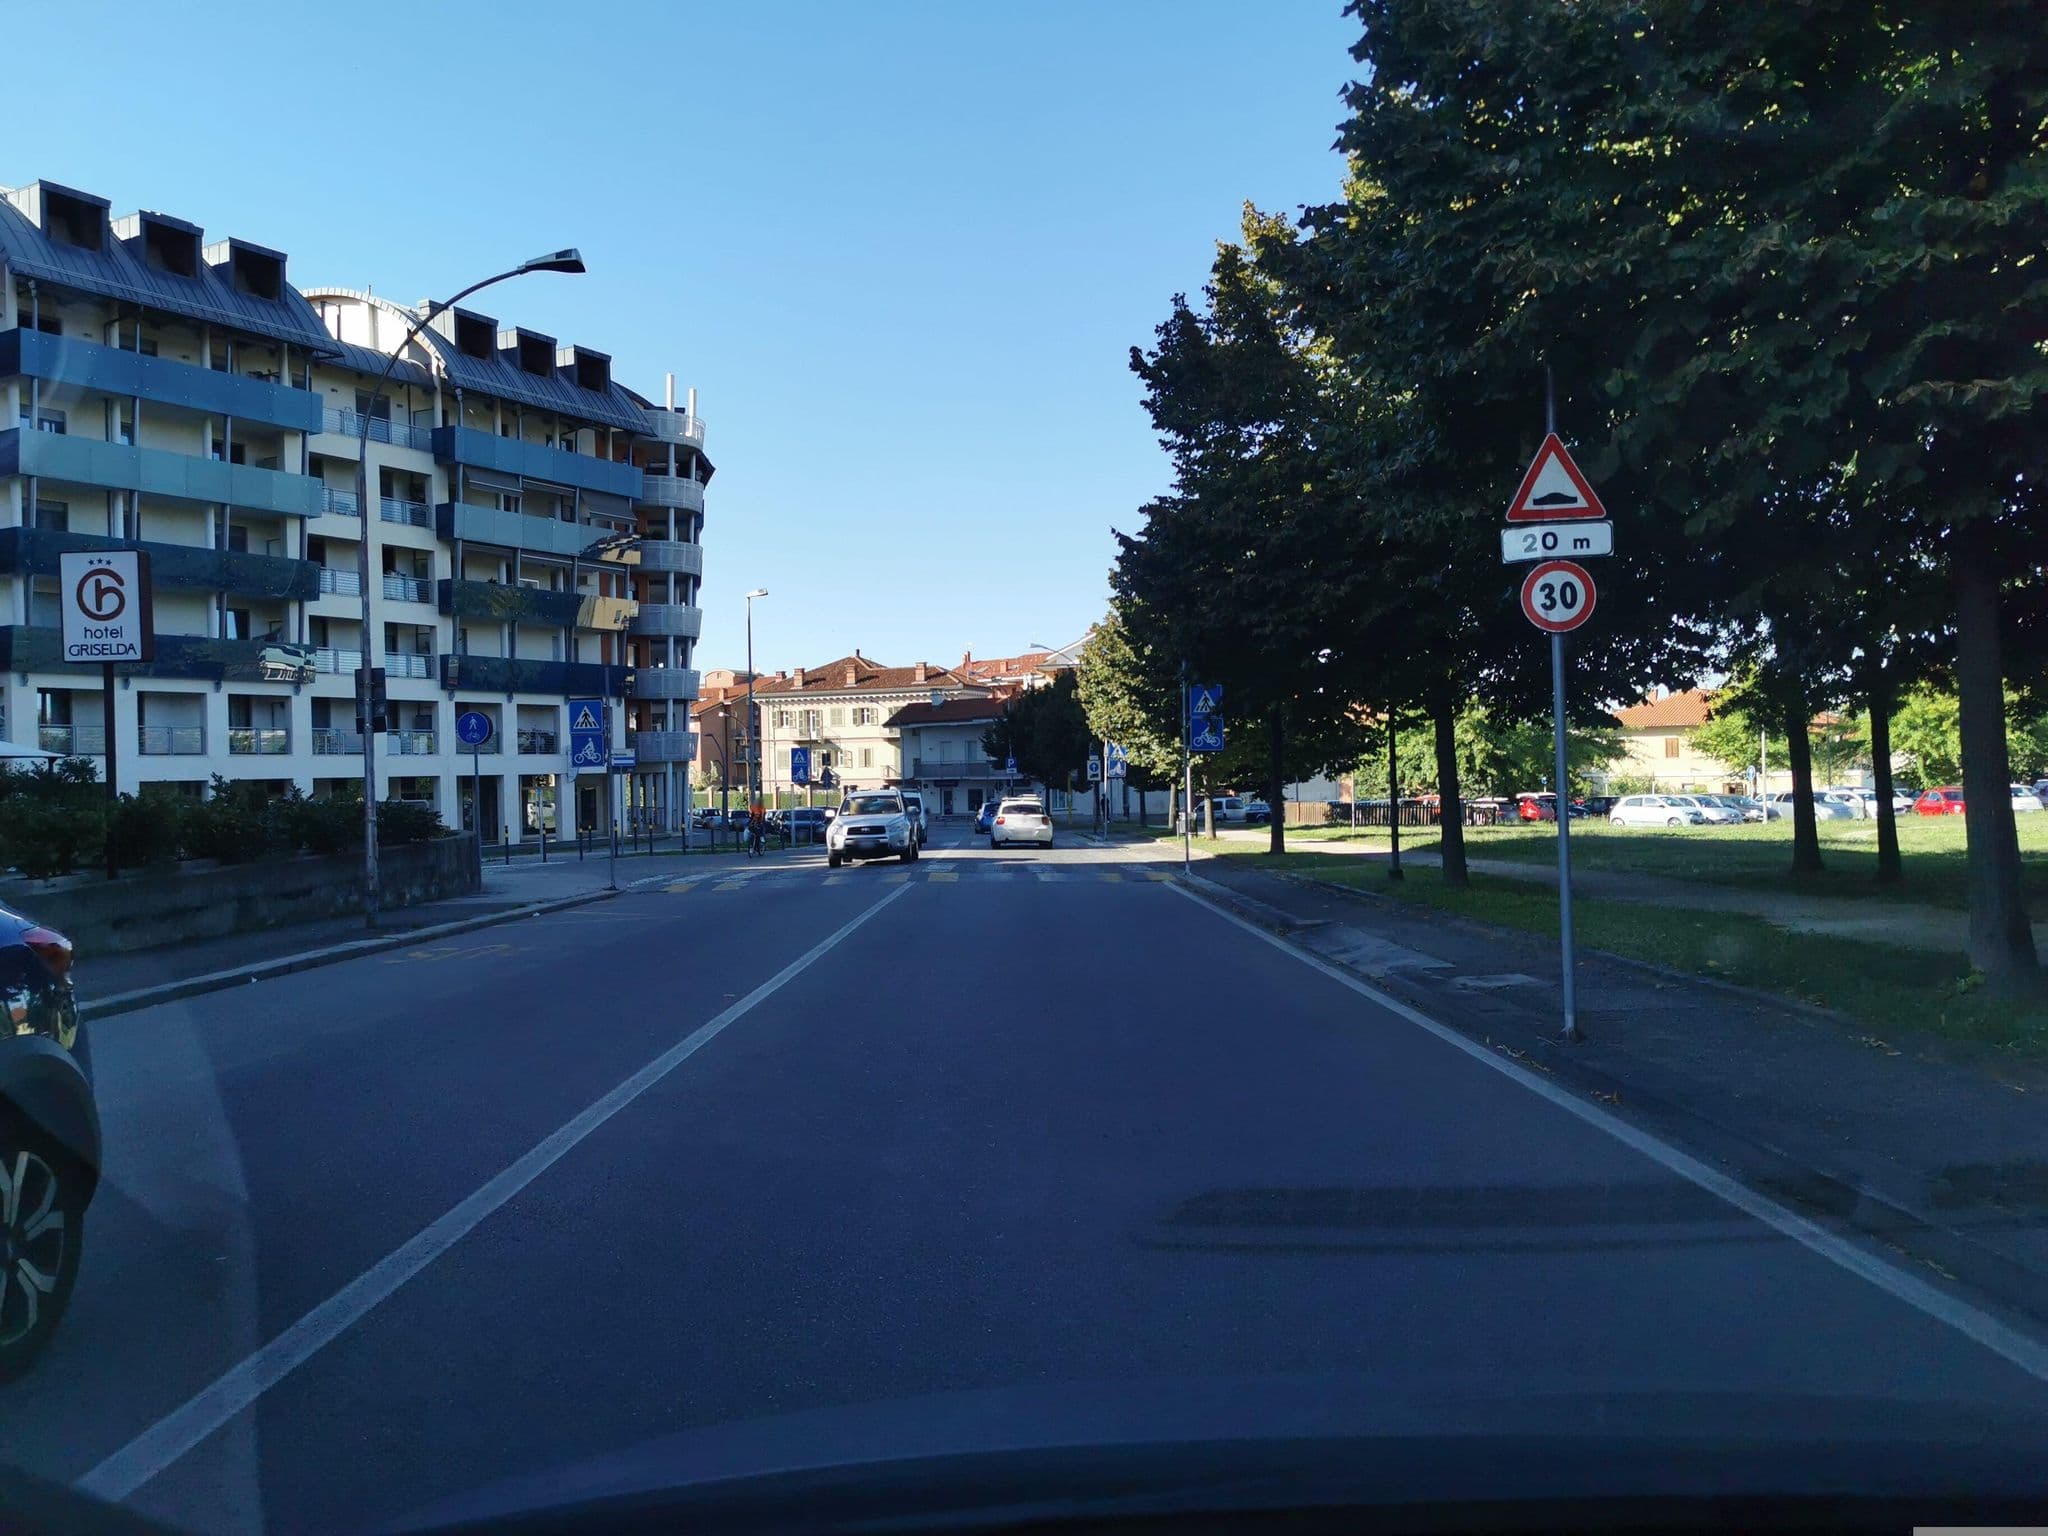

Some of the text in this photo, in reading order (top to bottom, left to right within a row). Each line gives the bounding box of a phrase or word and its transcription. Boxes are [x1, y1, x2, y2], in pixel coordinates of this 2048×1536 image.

[1522, 531, 1591, 554] 20 m
[1539, 581, 1578, 611] 30
[83, 626, 123, 639] hotel
[68, 643, 138, 657] GRISELDA
